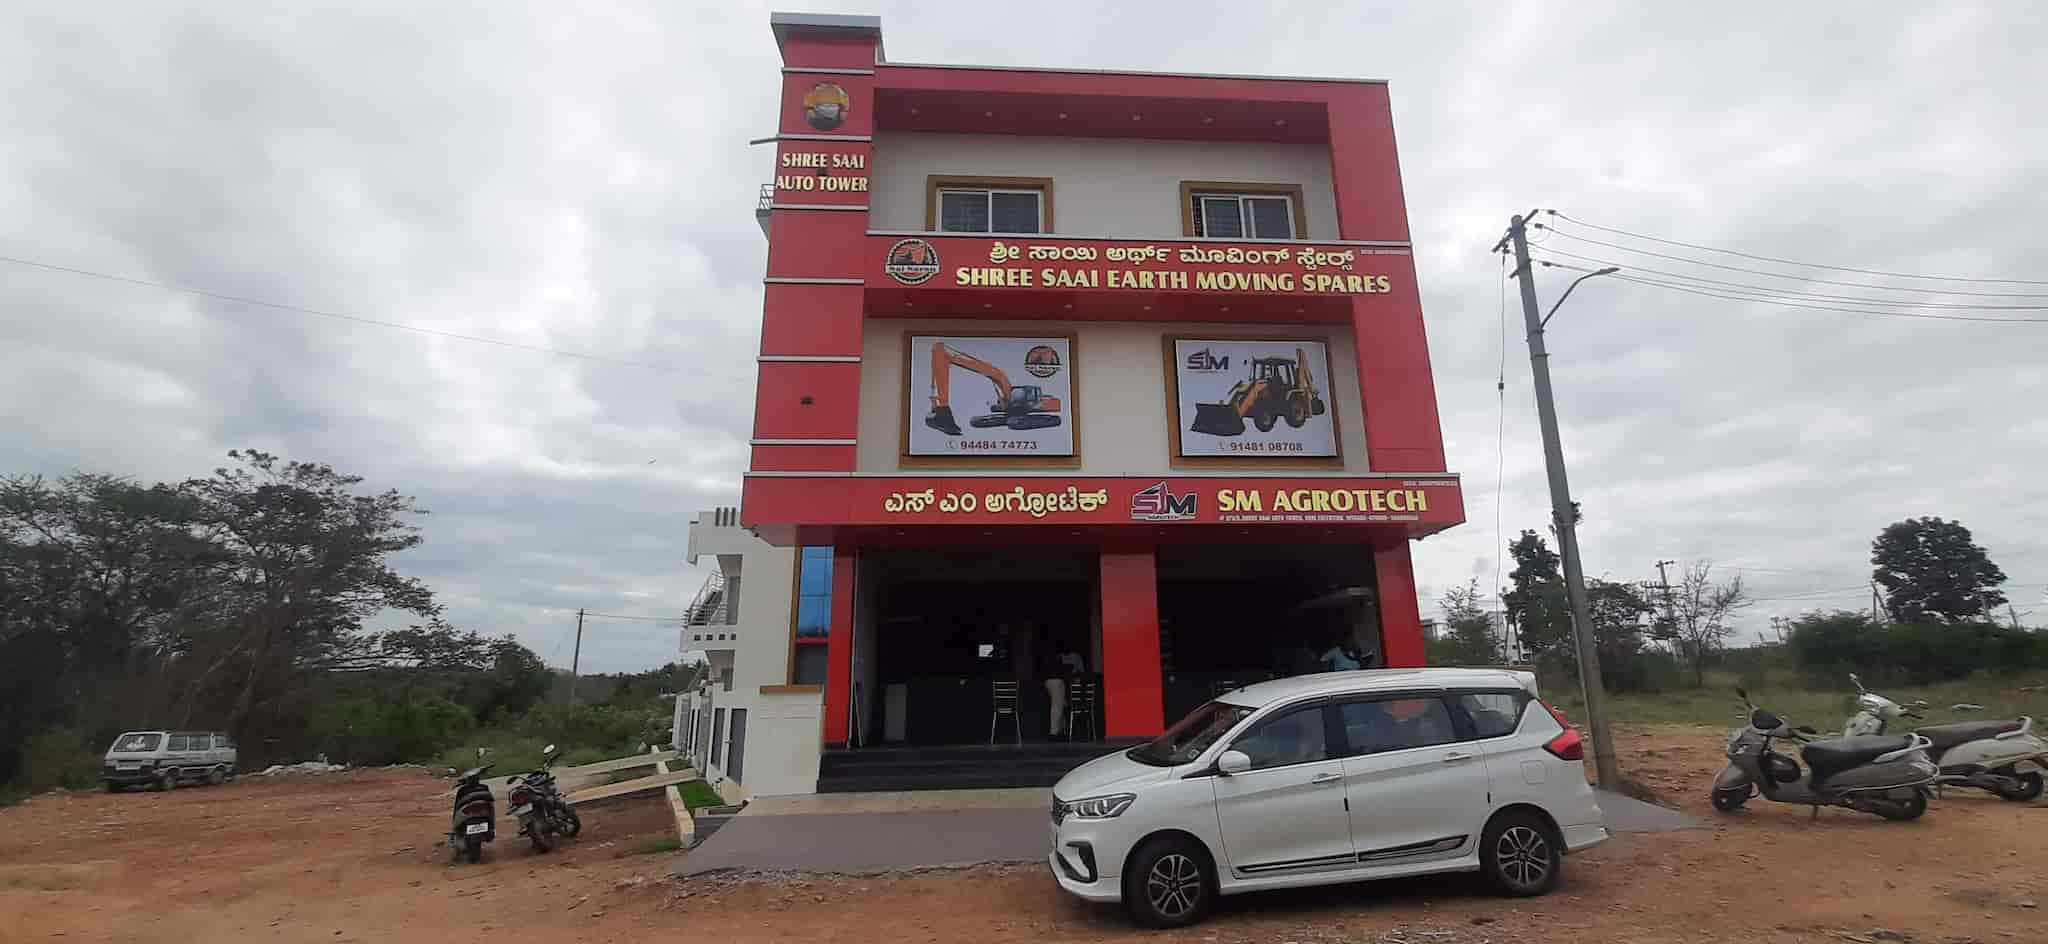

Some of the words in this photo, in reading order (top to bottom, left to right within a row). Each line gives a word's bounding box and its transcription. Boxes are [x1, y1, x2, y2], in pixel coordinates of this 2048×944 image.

[782, 152, 828, 167] SHREE
[832, 153, 865, 168] SAAI
[776, 175, 815, 190] AUTO
[818, 176, 868, 191] TOWER
[989, 241, 1021, 264] ಶ್ರೀ
[1028, 245, 1098, 260] ಸಾಯಿ
[1179, 245, 1291, 264] ಮೂವಿಂಗ್
[955, 267, 1033, 287] SHREE
[1040, 269, 1099, 288] SAAI
[1106, 270, 1188, 289] EARTH
[1196, 271, 1295, 291] MOVING
[1302, 274, 1392, 293] SPARES
[960, 440, 997, 450] 94484
[1000, 440, 1037, 450] 74773
[884, 488, 935, 513] ಎಸ್
[939, 491, 977, 512] ಎಂ
[985, 486, 1108, 518] ಅಗ್ರೋಟೆಕ್
[1217, 490, 1262, 512] SM
[1272, 490, 1427, 512] AGROTECH
